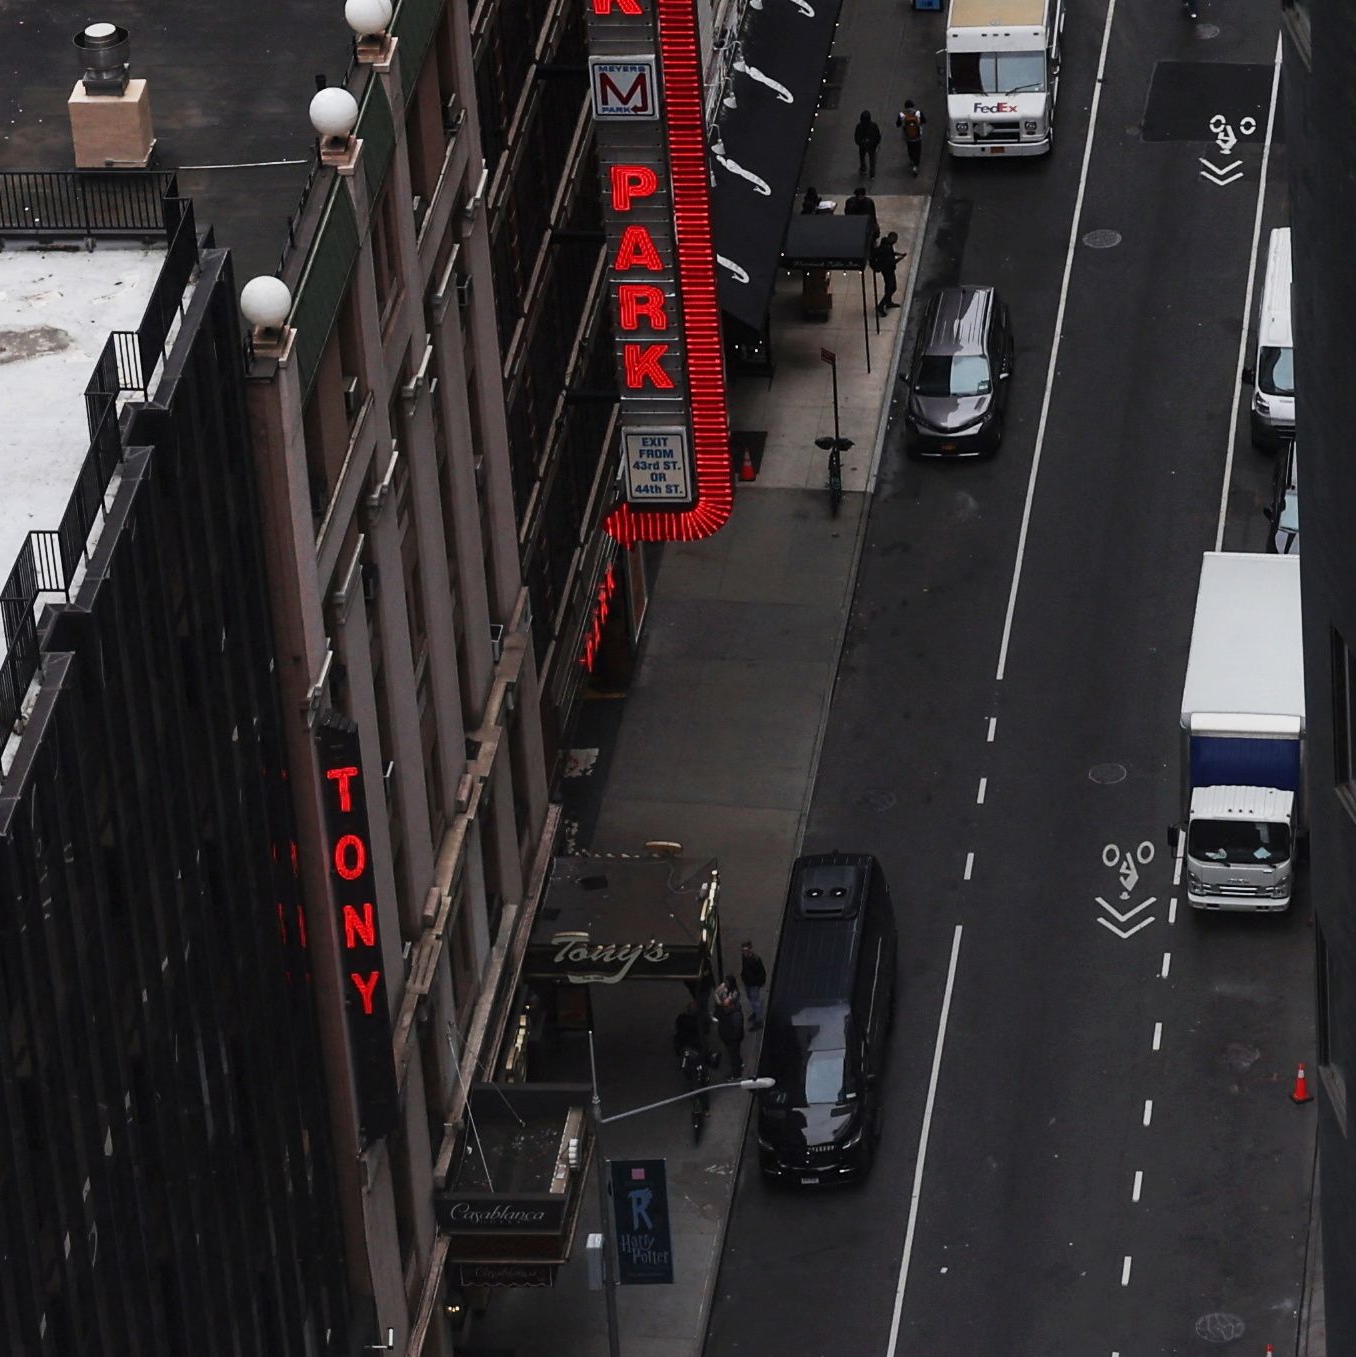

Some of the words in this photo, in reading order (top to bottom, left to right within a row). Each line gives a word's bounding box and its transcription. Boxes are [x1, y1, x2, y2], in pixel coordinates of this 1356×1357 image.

[973, 102, 1018, 114] FedEx
[610, 165, 674, 389] PARK
[641, 437, 668, 447] EXIT
[639, 449, 674, 458] FROM
[633, 461, 660, 470] 43rd
[663, 461, 681, 470] ST.
[650, 472, 666, 482] OR
[635, 484, 662, 494] 44th
[665, 484, 683, 494] ST.
[327, 767, 381, 1014] TONY
[551, 932, 670, 984] Tony's
[450, 1202, 545, 1223] Casablanca
